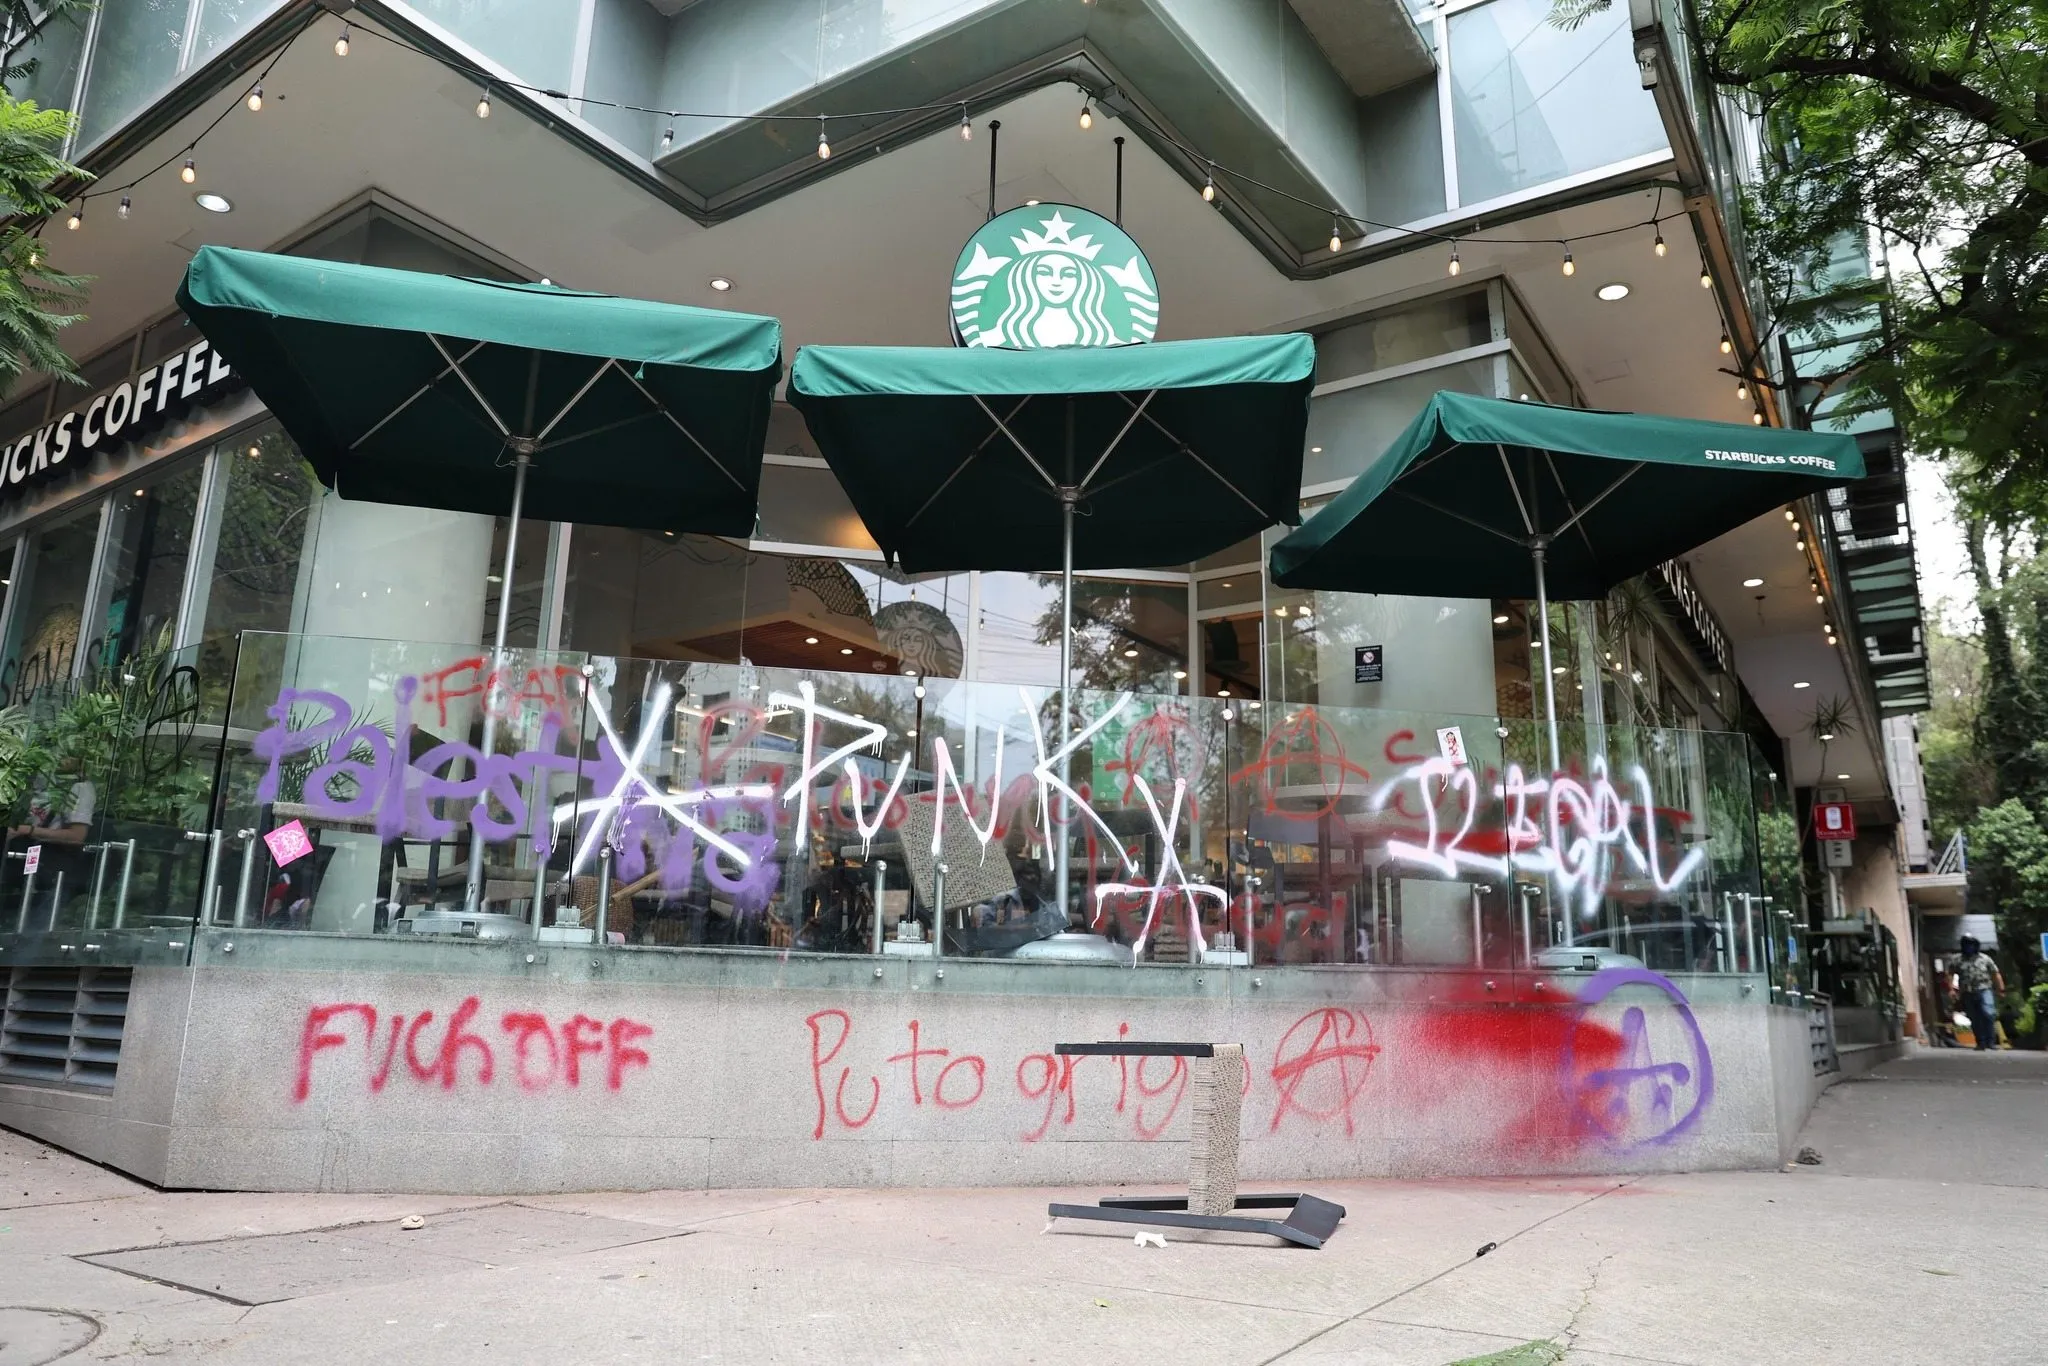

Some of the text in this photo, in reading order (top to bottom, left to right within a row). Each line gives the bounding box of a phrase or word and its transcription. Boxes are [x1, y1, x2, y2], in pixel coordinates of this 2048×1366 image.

[1704, 449, 1837, 471] STARBUCKS COFFEE
[804, 1008, 988, 1142] Puto
